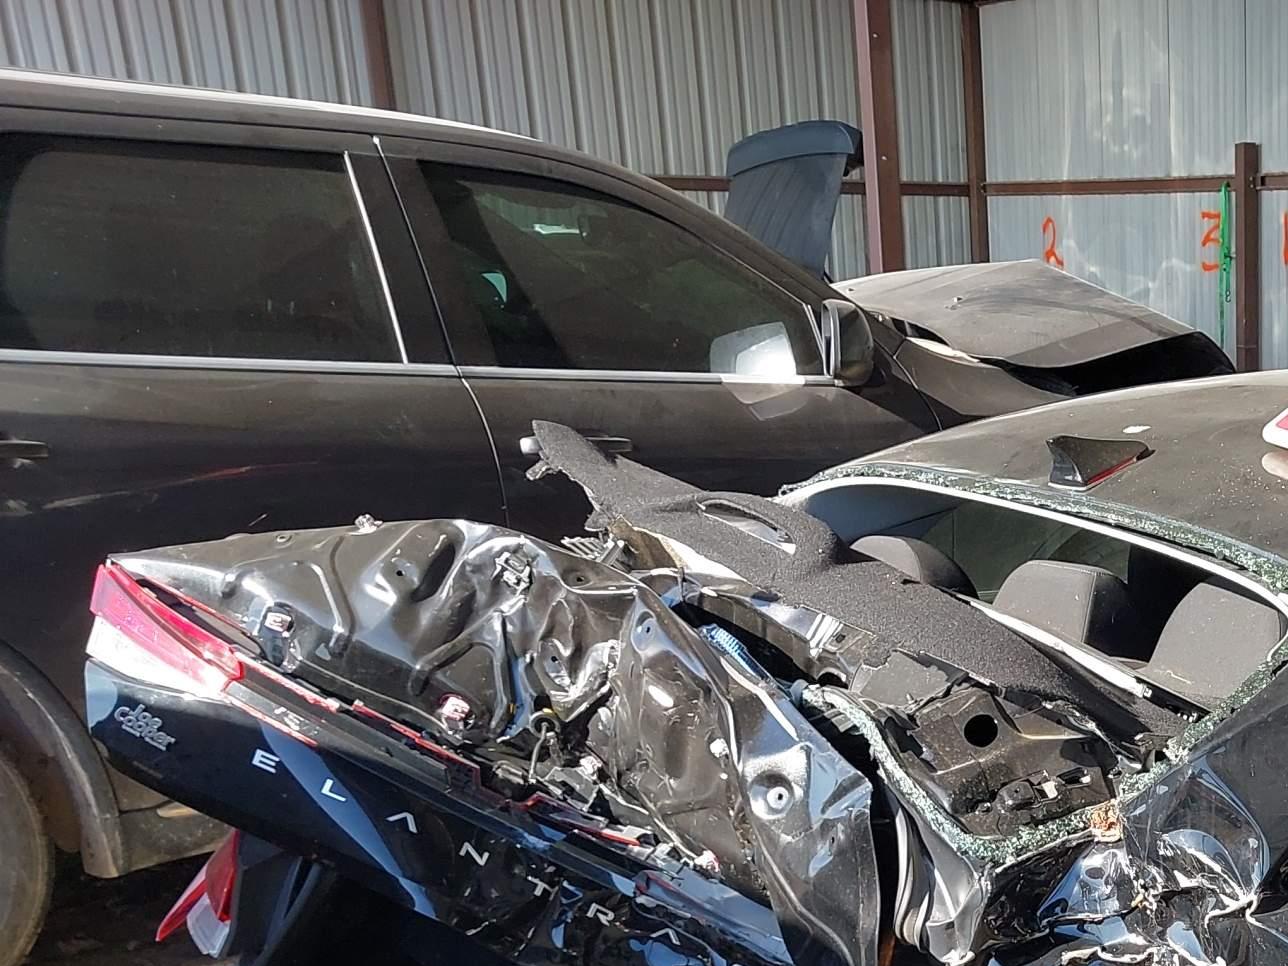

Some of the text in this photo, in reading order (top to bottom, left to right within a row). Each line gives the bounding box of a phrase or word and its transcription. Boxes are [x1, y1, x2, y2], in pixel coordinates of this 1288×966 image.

[1042, 216, 1065, 268] 2
[1201, 211, 1223, 273] 3
[114, 706, 176, 746] Cooper
[127, 703, 163, 729] Joe
